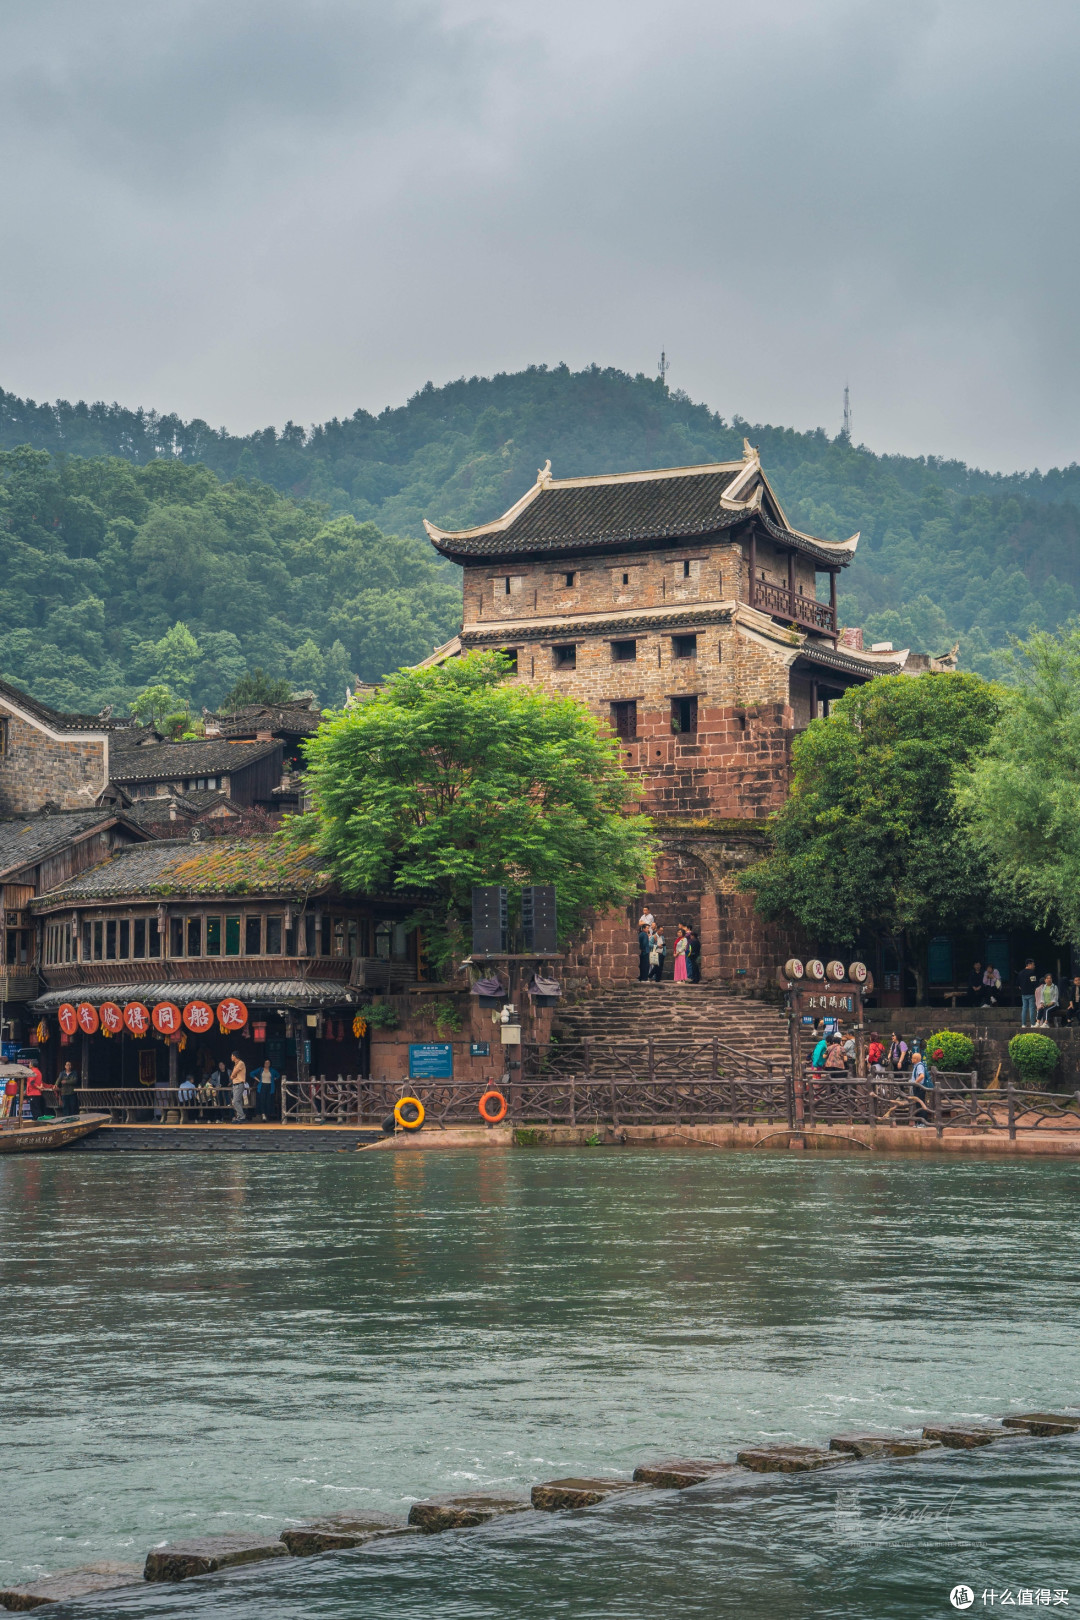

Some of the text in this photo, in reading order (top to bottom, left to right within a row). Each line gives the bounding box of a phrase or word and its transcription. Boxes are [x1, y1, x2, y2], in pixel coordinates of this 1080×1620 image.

[809, 995, 848, 1009] 北門碼頭
[60, 1002, 244, 1031] 千年修得同船渡
